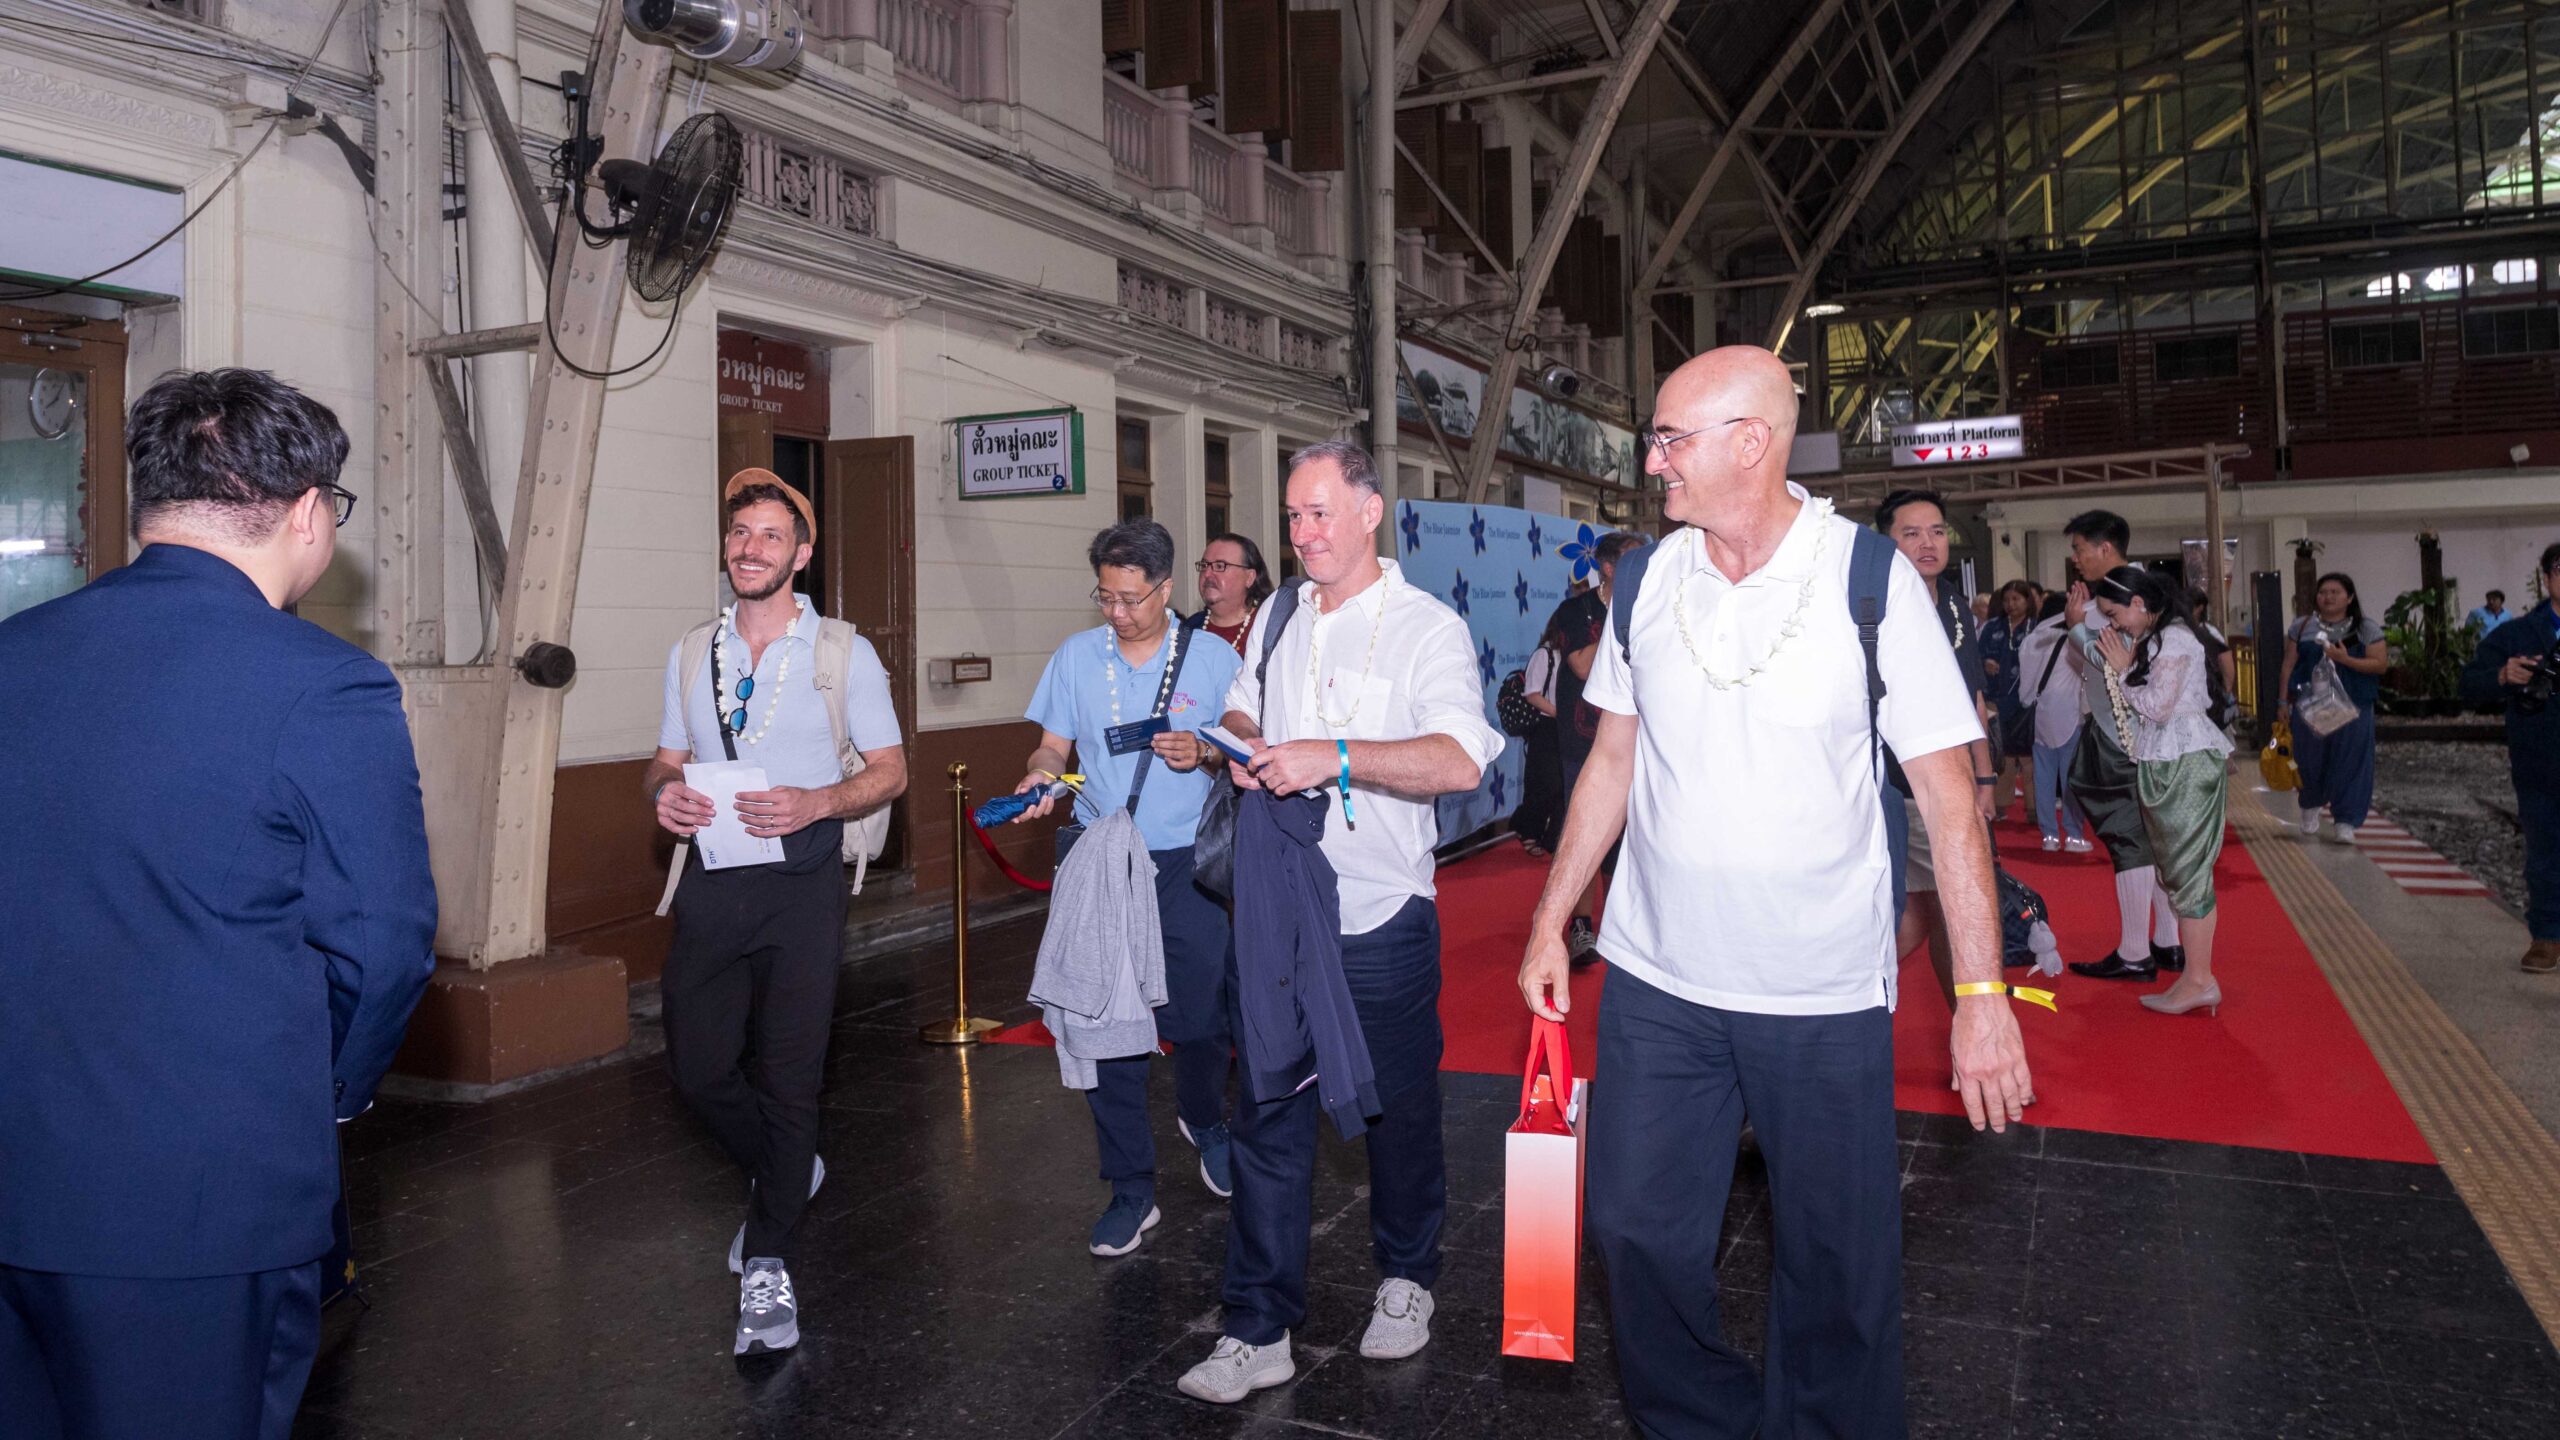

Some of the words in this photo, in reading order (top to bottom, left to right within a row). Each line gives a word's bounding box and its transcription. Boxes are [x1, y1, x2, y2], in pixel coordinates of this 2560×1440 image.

[719, 352, 805, 396] วหมู่คณะ
[720, 393, 750, 408] GROUP
[752, 399, 783, 413] TICKET
[1961, 426, 2020, 441] Platform
[1945, 446, 1954, 461] 1
[1961, 445, 1972, 460] 2
[1978, 443, 1989, 458] 3
[973, 466, 1013, 482] GROUP
[1017, 463, 1059, 479] TICKET
